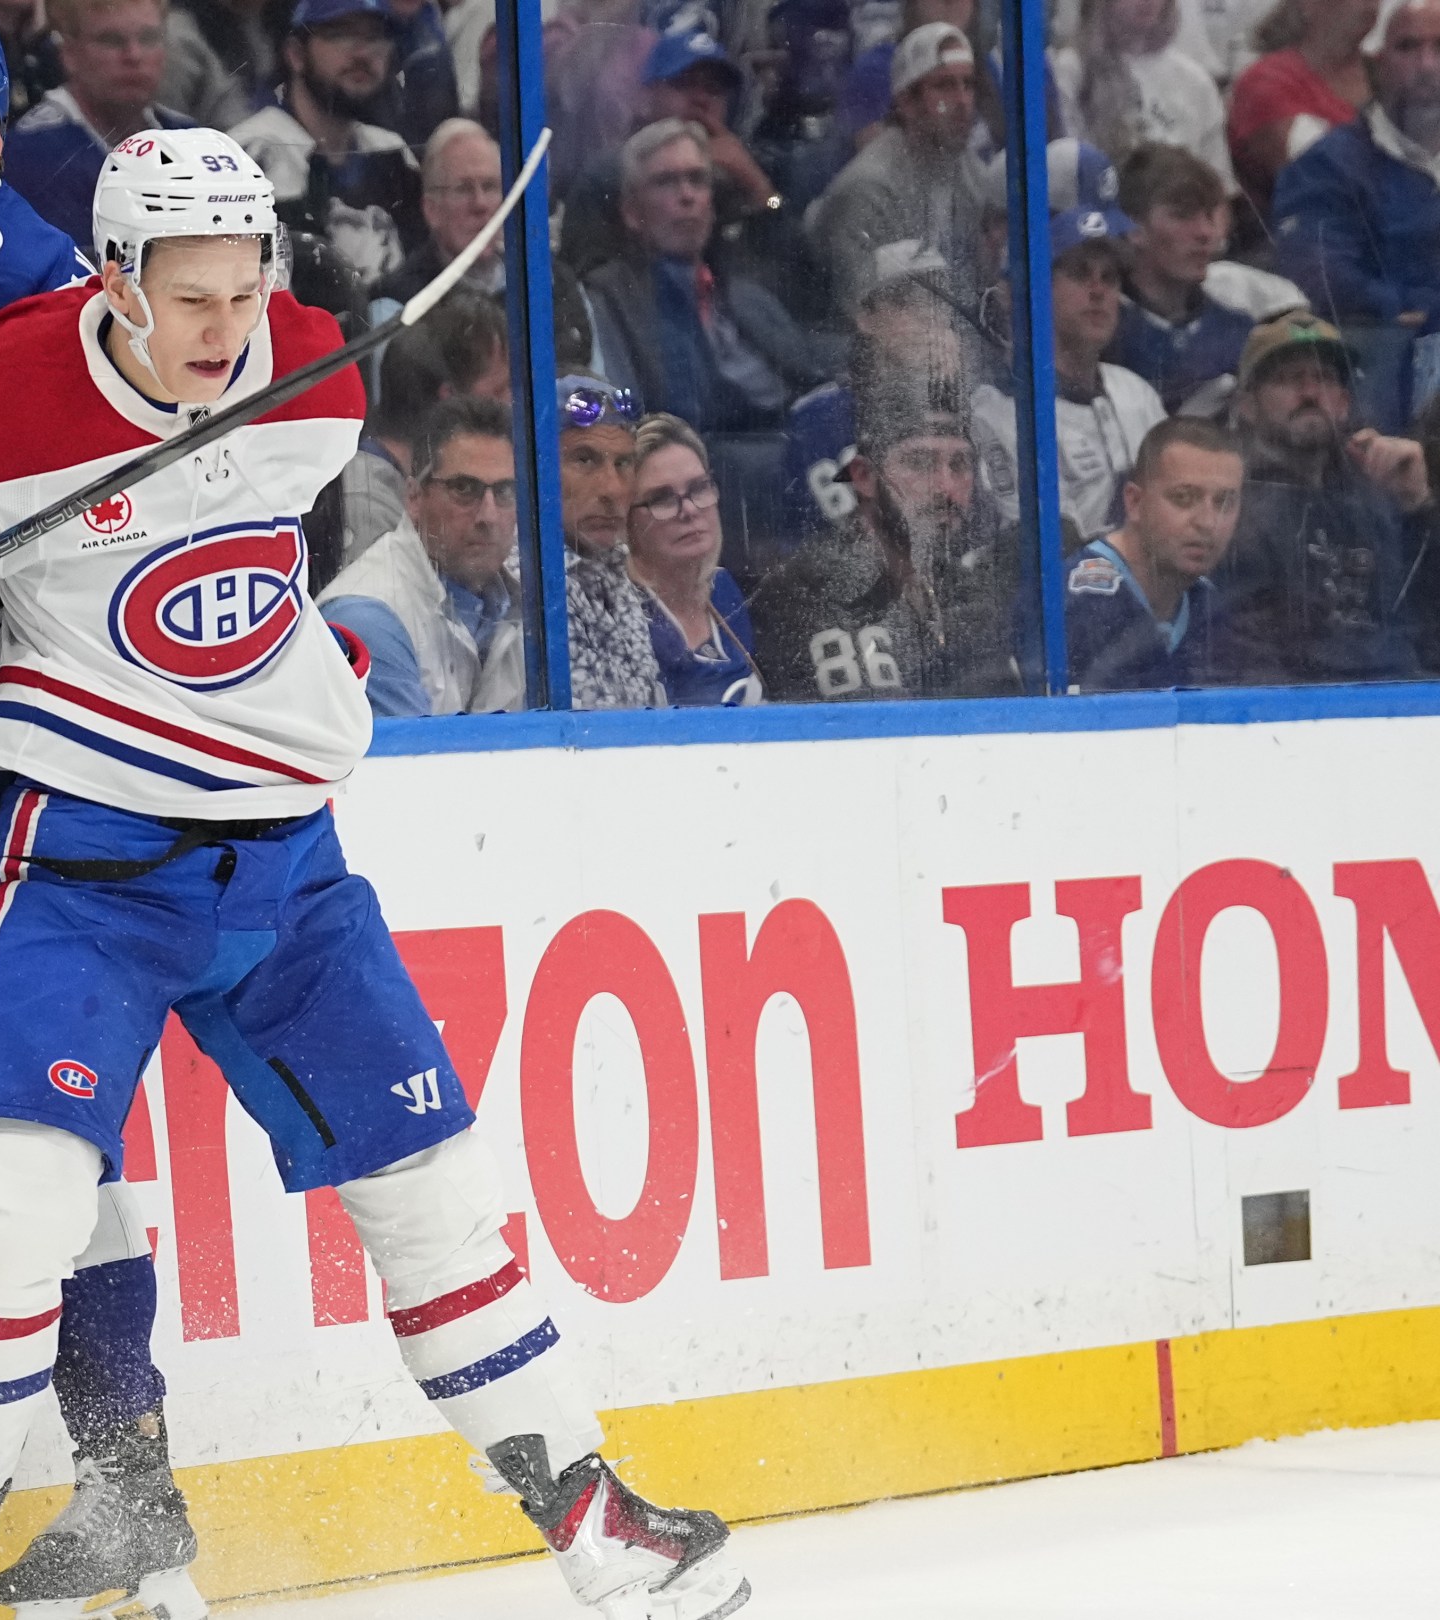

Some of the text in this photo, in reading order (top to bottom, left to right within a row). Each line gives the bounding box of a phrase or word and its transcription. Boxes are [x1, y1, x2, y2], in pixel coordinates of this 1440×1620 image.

[201, 154, 239, 172] 93
[207, 194, 256, 203] BAUER
[81, 529, 148, 550] AIR CANADA
[810, 624, 903, 696] 86
